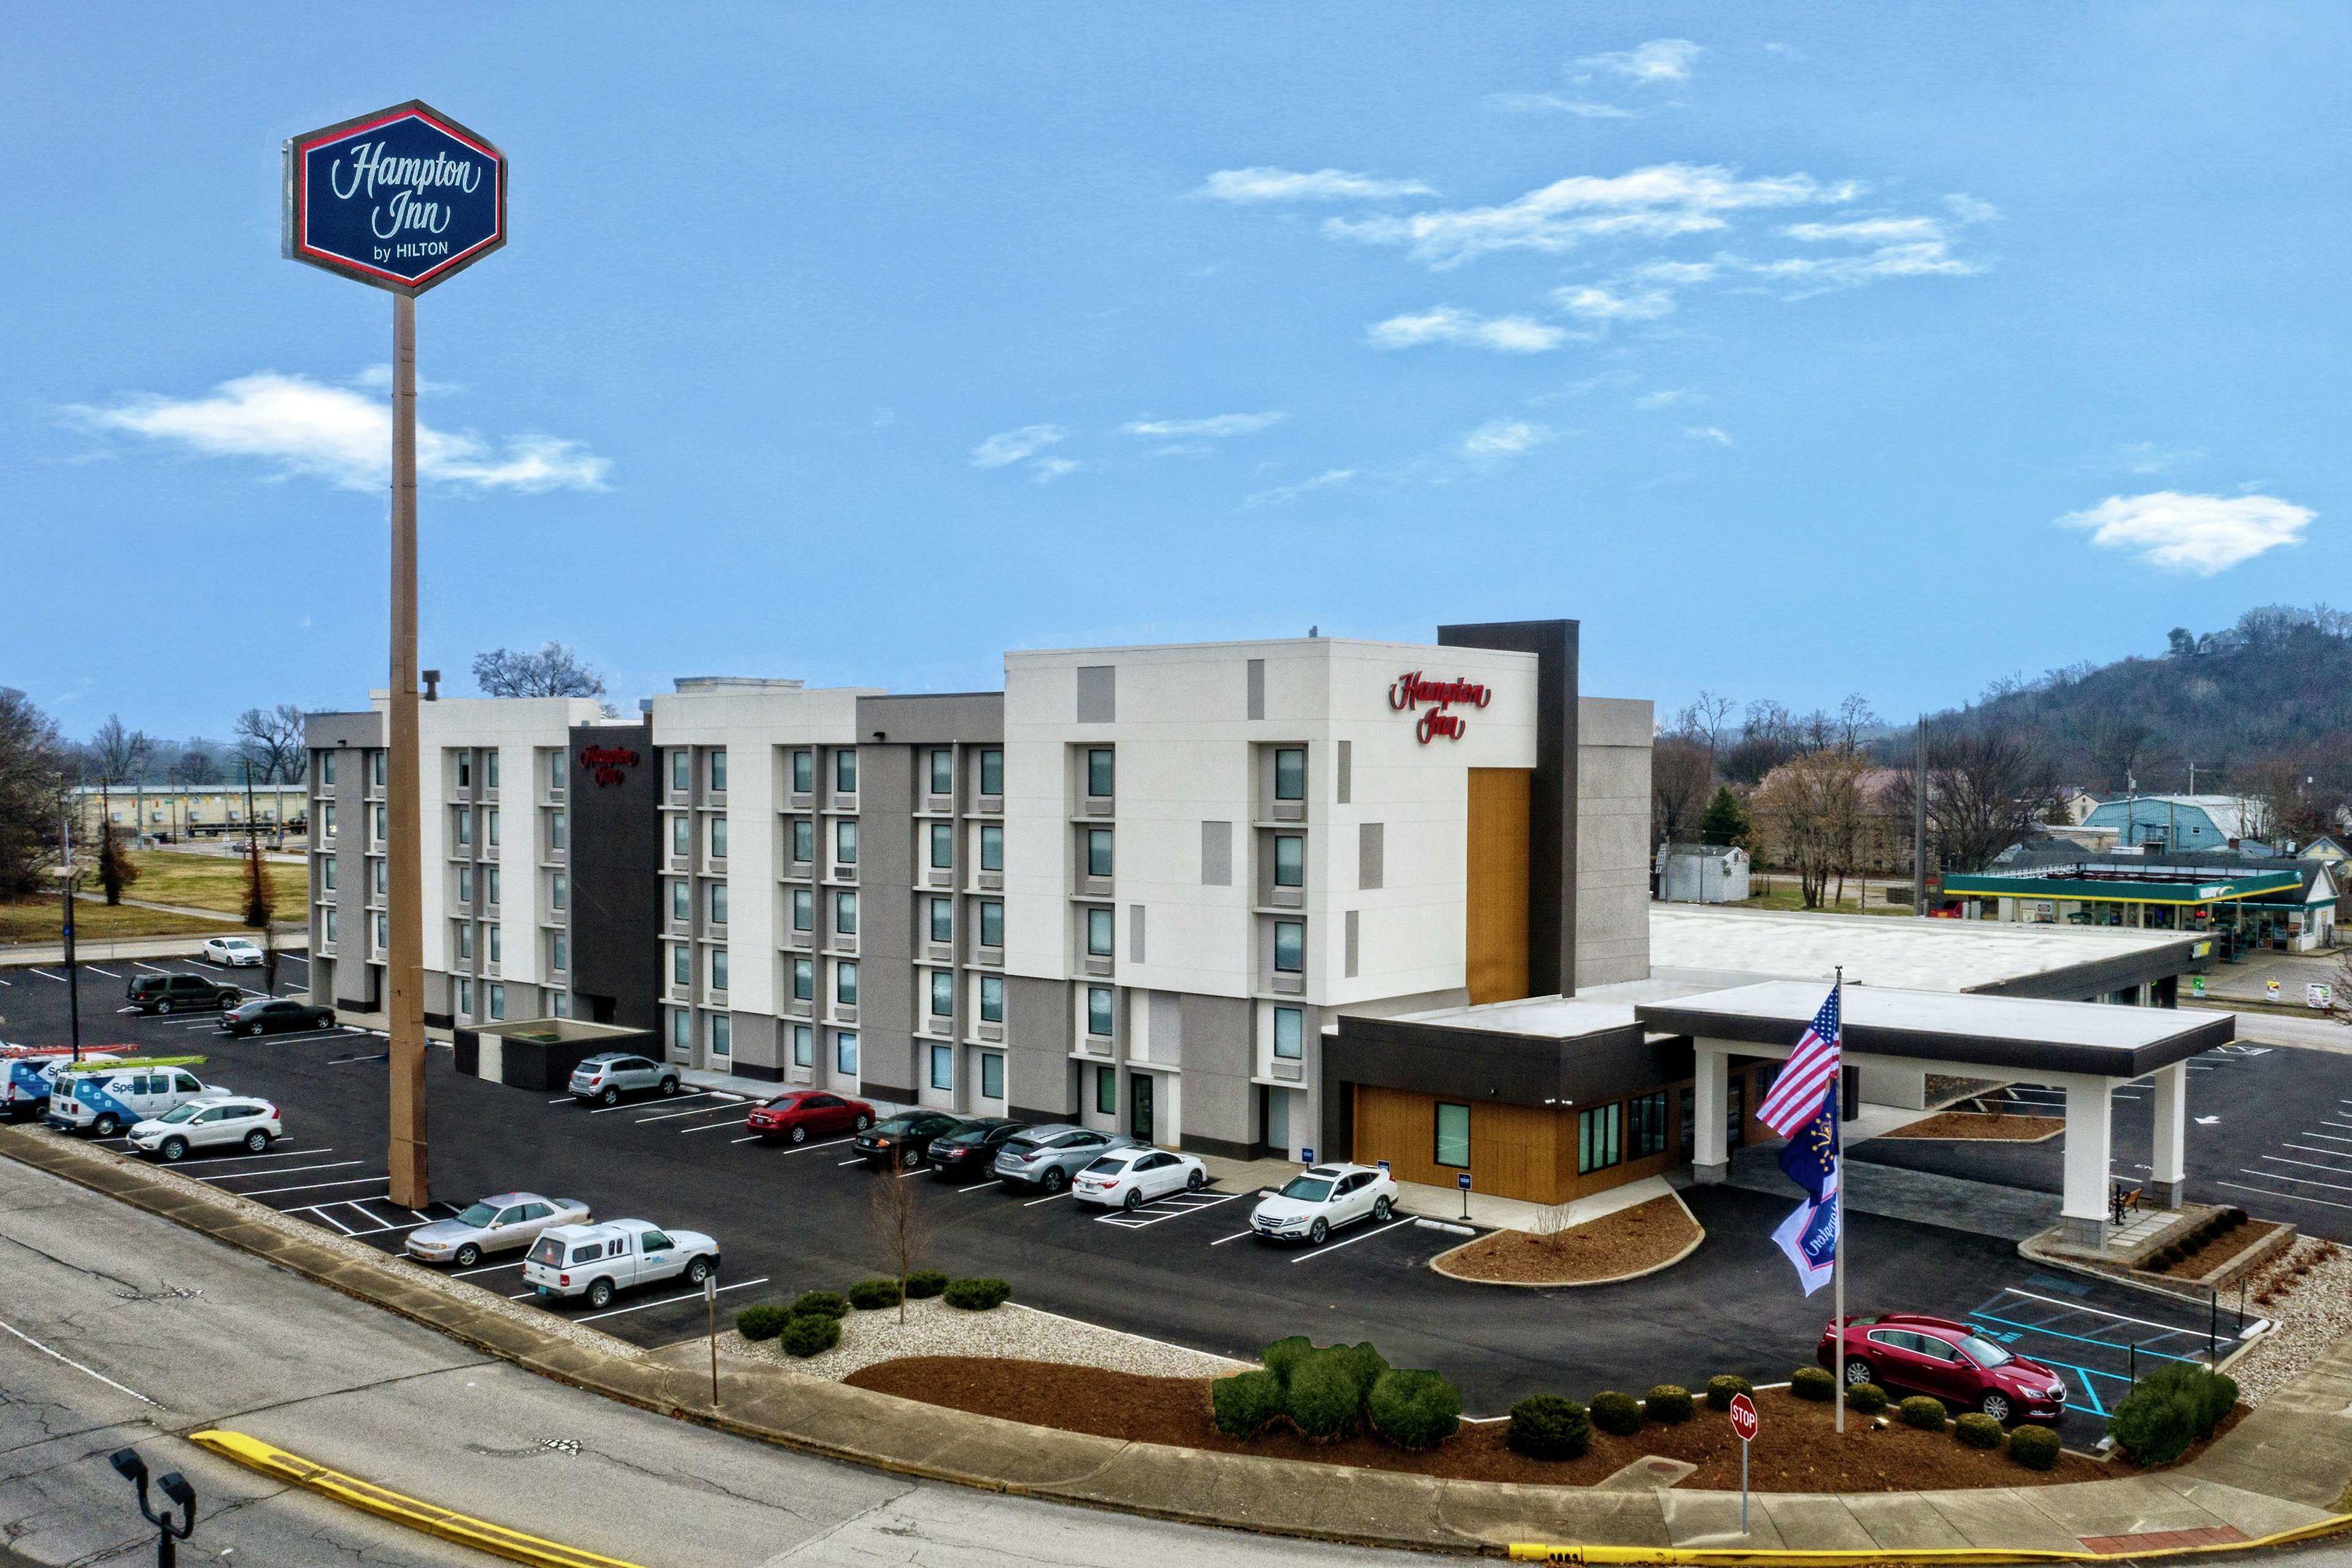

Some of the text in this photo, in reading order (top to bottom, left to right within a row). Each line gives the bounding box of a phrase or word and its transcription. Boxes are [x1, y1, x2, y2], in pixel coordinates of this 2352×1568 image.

[332, 141, 481, 200] Hampton
[372, 189, 451, 239] Inn
[374, 242, 449, 263] by HILTON
[1389, 670, 1492, 711] Hampton
[1416, 706, 1466, 744] Inn
[1732, 1405, 1755, 1429] STOP
